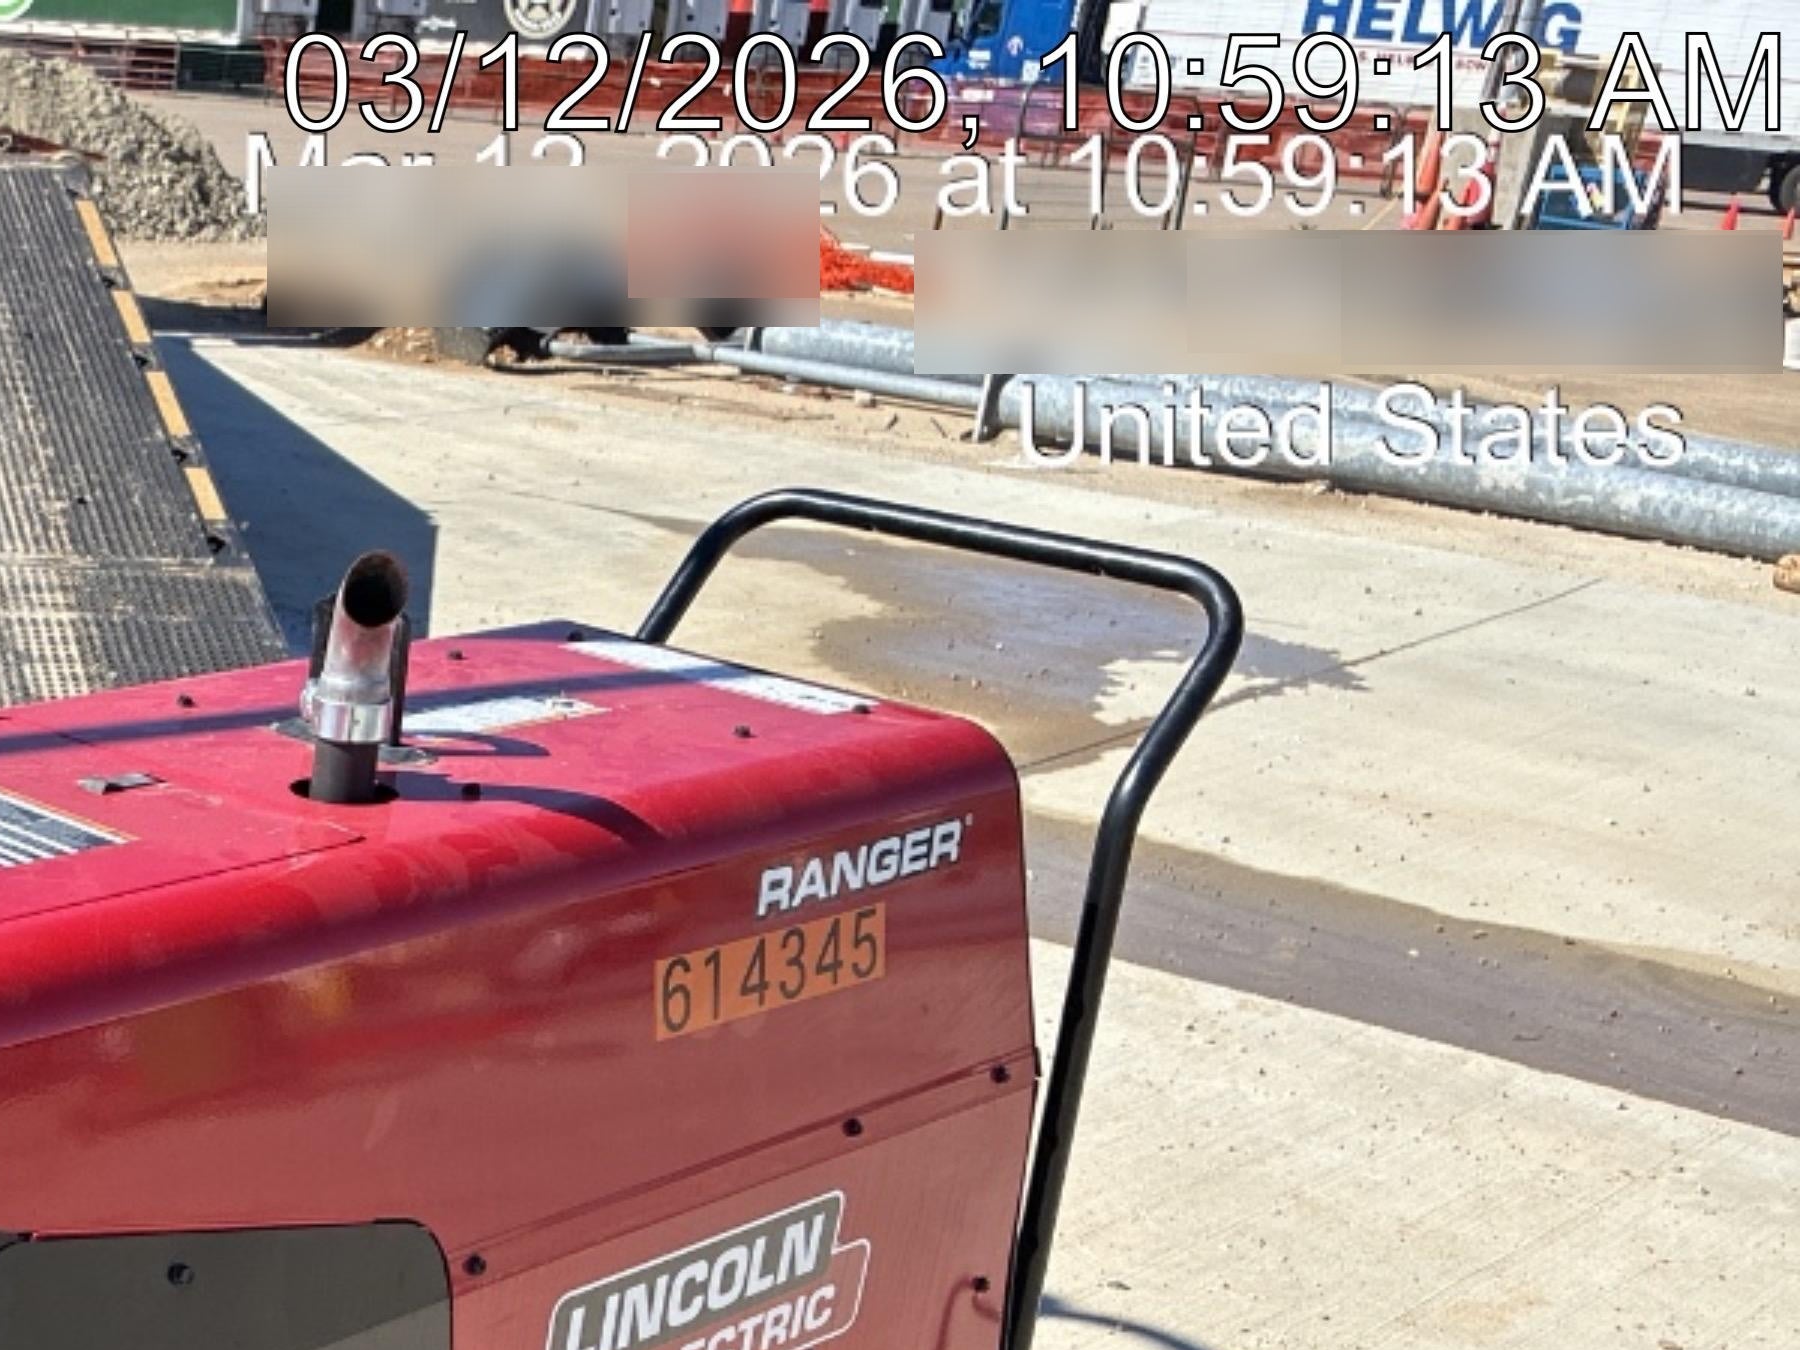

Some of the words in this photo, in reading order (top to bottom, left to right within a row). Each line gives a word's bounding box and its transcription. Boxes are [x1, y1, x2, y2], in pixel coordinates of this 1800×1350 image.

[1302, 0, 1583, 54] HELWG
[756, 817, 963, 917] RANGER
[661, 906, 880, 1034] 614345
